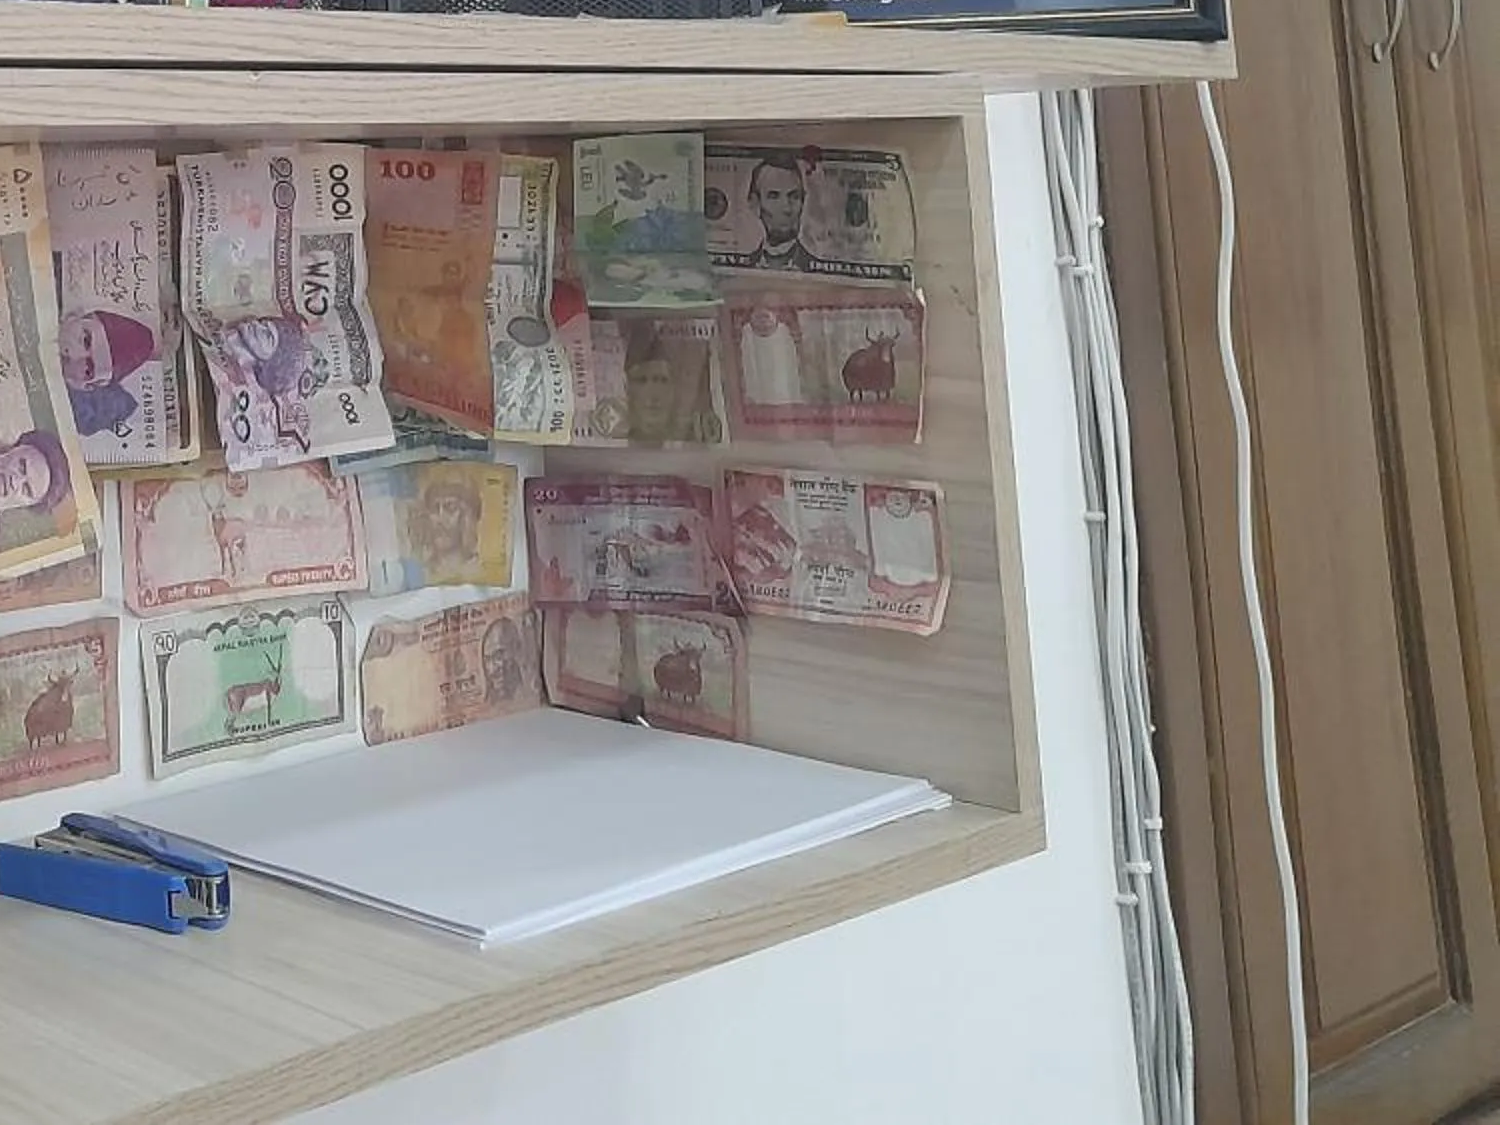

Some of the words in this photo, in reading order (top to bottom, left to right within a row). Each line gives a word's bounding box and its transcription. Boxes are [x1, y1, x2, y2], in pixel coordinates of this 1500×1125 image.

[269, 156, 297, 210] 20
[379, 159, 436, 182] 100
[328, 163, 354, 221] 1000
[338, 392, 361, 425] 1000
[533, 489, 558, 501] 20
[323, 603, 339, 621] 10
